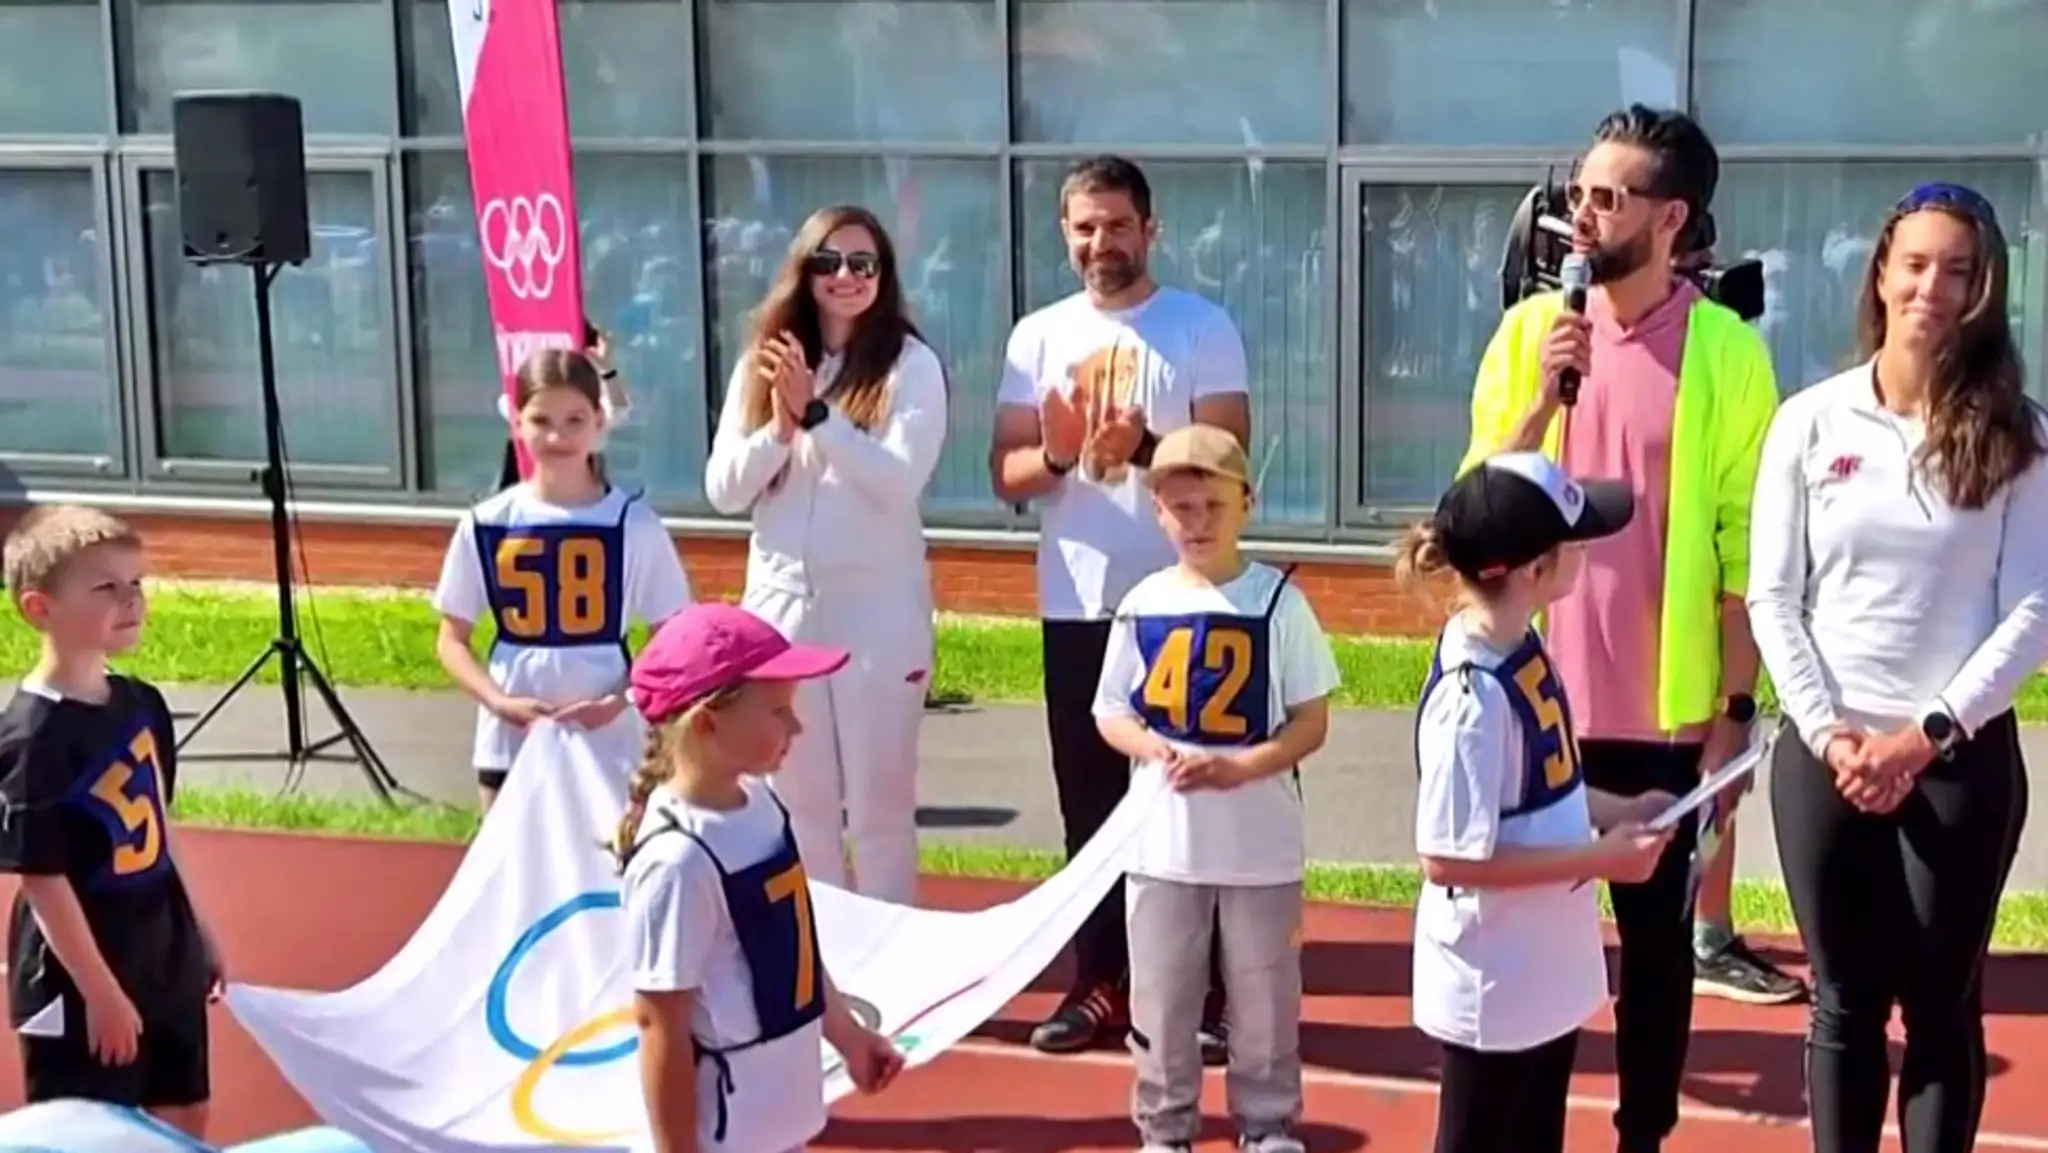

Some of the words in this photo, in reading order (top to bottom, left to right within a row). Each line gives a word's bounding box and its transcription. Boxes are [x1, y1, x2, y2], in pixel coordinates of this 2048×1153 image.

[496, 537, 606, 637] 58
[1143, 626, 1252, 735] 42
[764, 863, 814, 1011] 7
